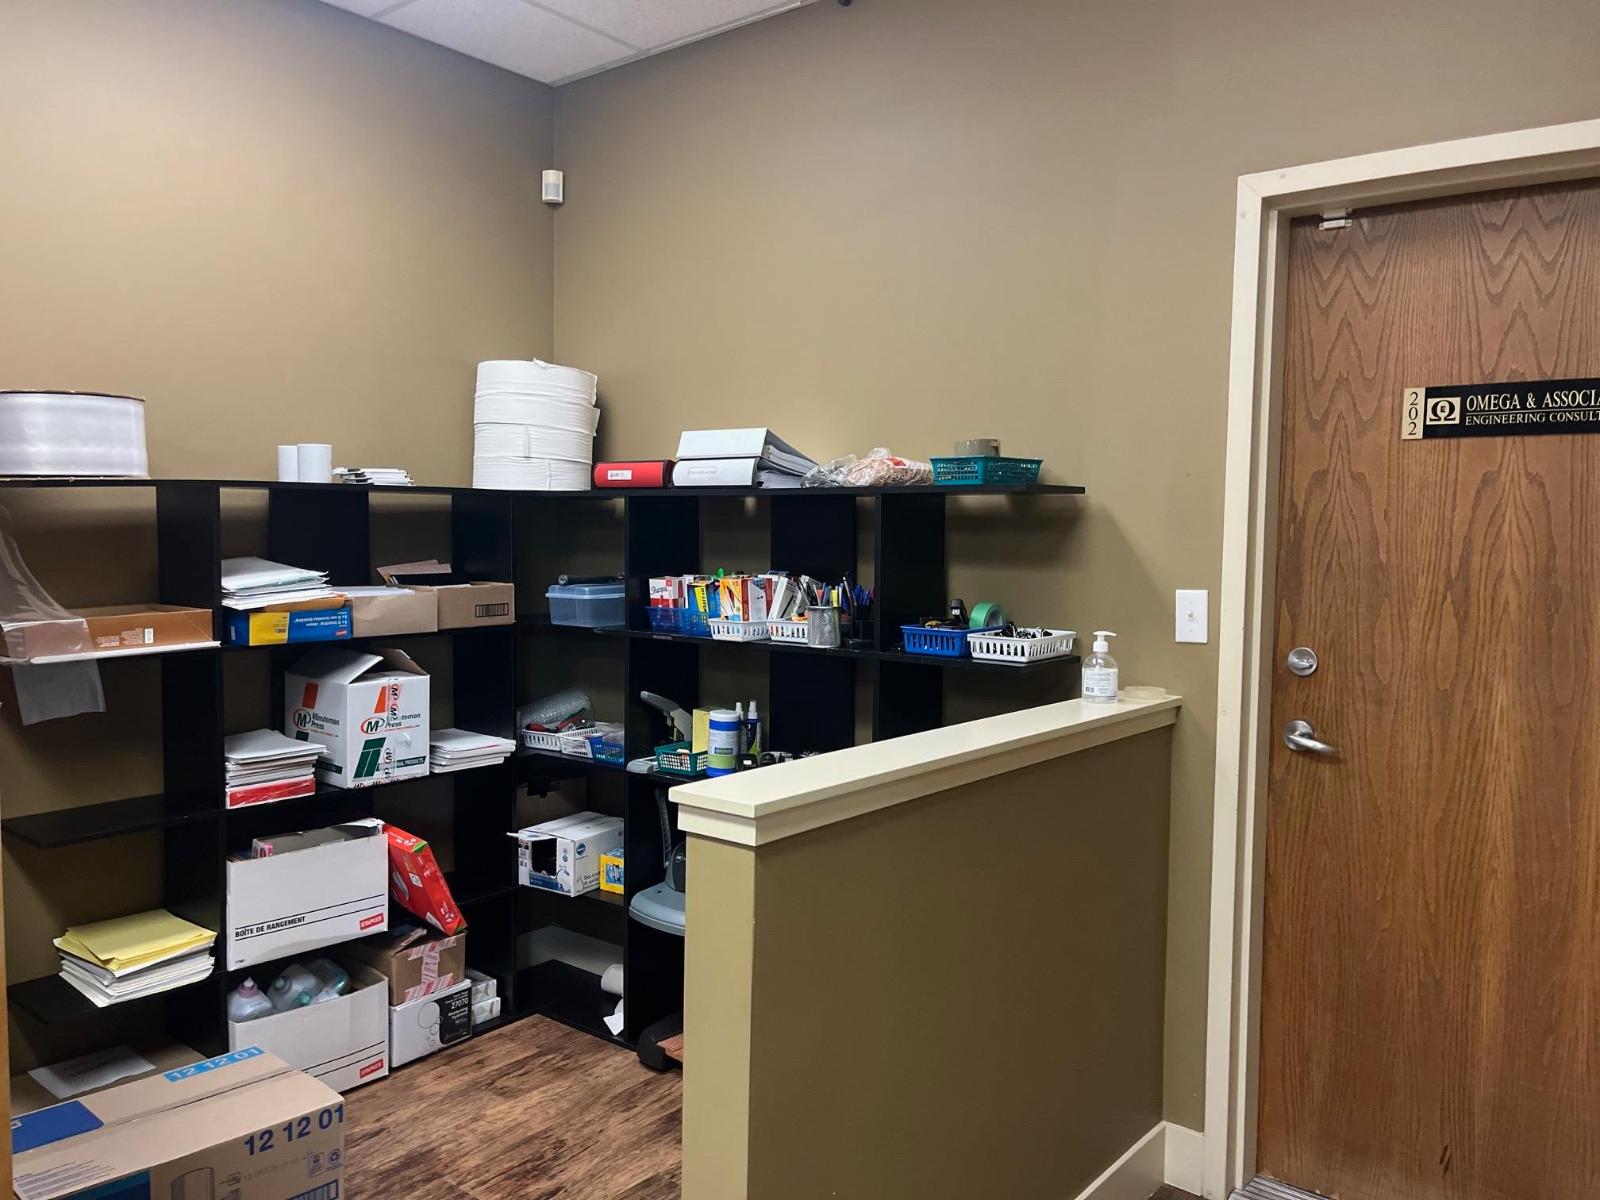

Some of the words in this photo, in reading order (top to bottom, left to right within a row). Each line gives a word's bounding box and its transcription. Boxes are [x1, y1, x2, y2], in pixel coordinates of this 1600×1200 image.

[1466, 393, 1521, 411] OMEGA
[1526, 392, 1537, 409] &
[1465, 412, 1546, 426] ENGINEERING
[235, 927, 255, 938] BOÎTE
[256, 925, 265, 933] DE
[266, 916, 306, 931] RANGEMENT
[170, 1067, 197, 1079] 12
[203, 1057, 230, 1069] 12
[233, 1048, 260, 1060] 01
[244, 1129, 275, 1156] 12
[283, 1116, 311, 1143] 12
[318, 1103, 344, 1130] 01
